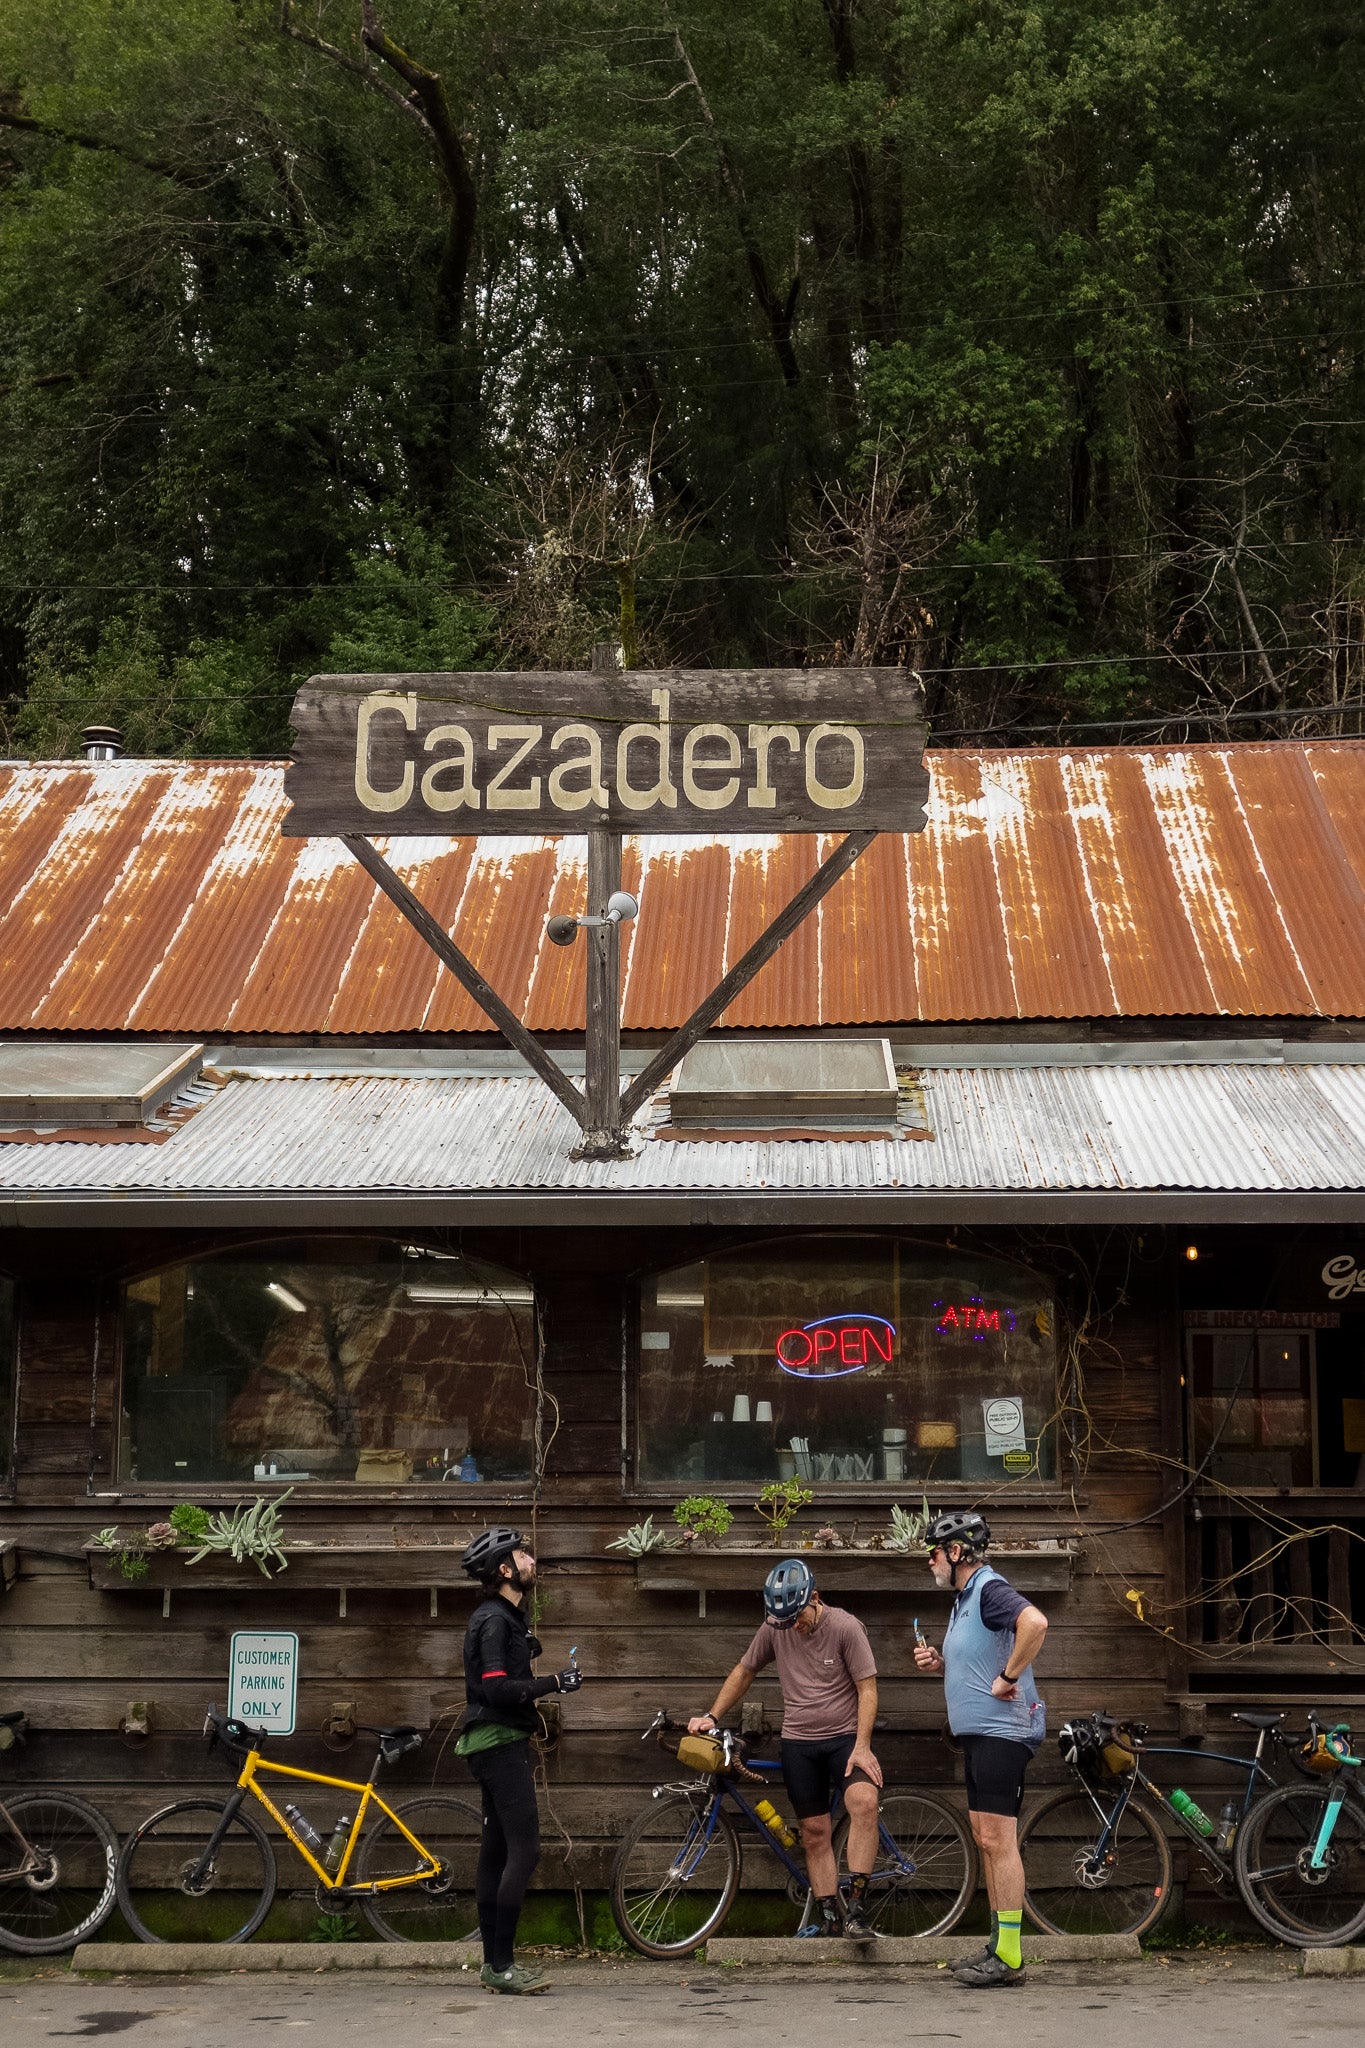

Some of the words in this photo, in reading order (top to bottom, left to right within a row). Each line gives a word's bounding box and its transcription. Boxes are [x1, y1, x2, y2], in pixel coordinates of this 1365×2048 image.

[353, 688, 866, 813] Cazadero
[941, 1305, 999, 1331] ATM
[777, 1328, 893, 1365] OPEN
[237, 1651, 291, 1665] CUSTOMER
[240, 1676, 285, 1690] PARKING
[242, 1702, 282, 1716] ONLY
